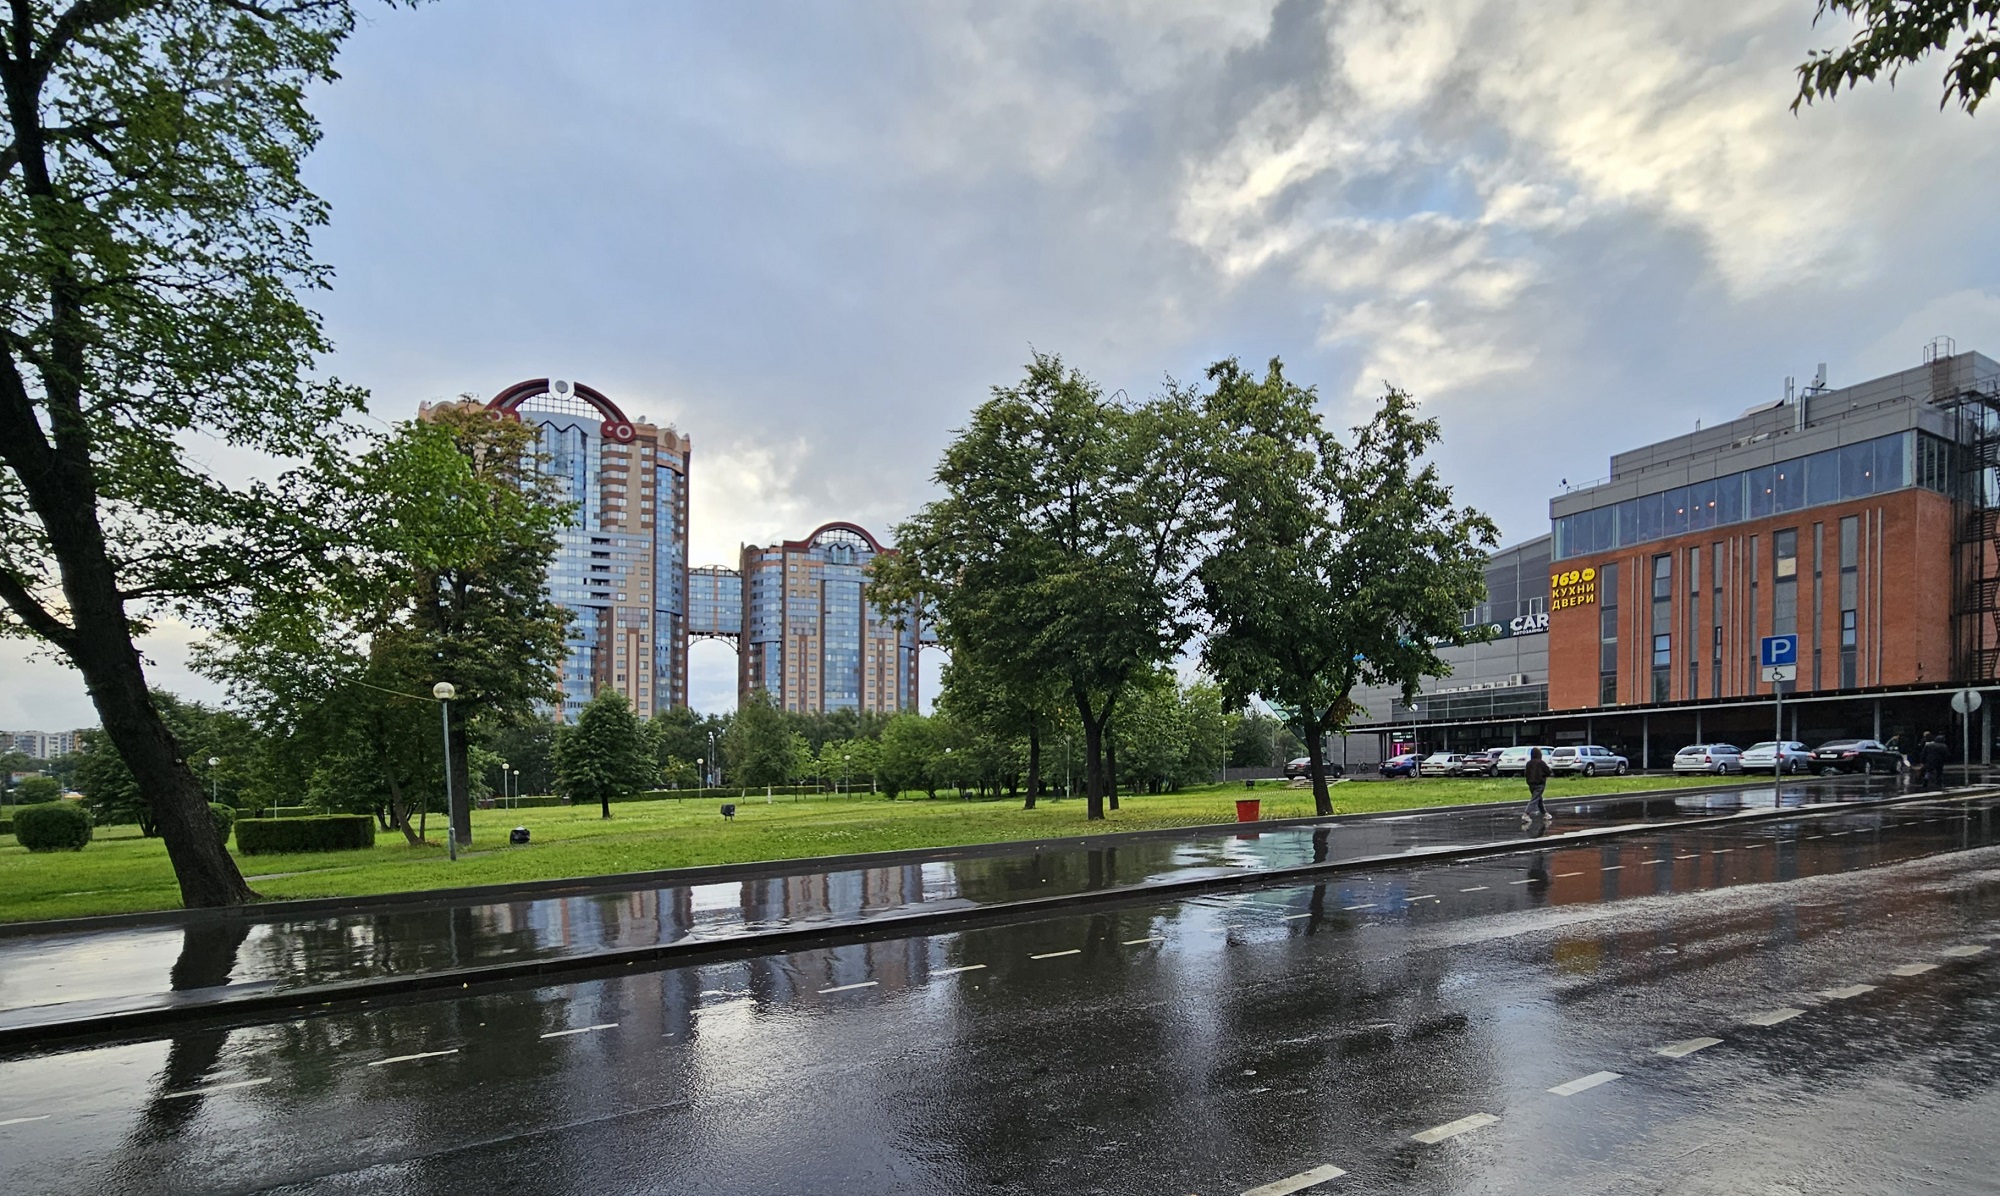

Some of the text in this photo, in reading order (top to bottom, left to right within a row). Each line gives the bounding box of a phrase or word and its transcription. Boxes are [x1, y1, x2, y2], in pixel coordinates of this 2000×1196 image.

[1552, 582, 1594, 599] КУХНИ
[1552, 593, 1594, 611] ДВЕРИ
[1771, 638, 1791, 663] P
